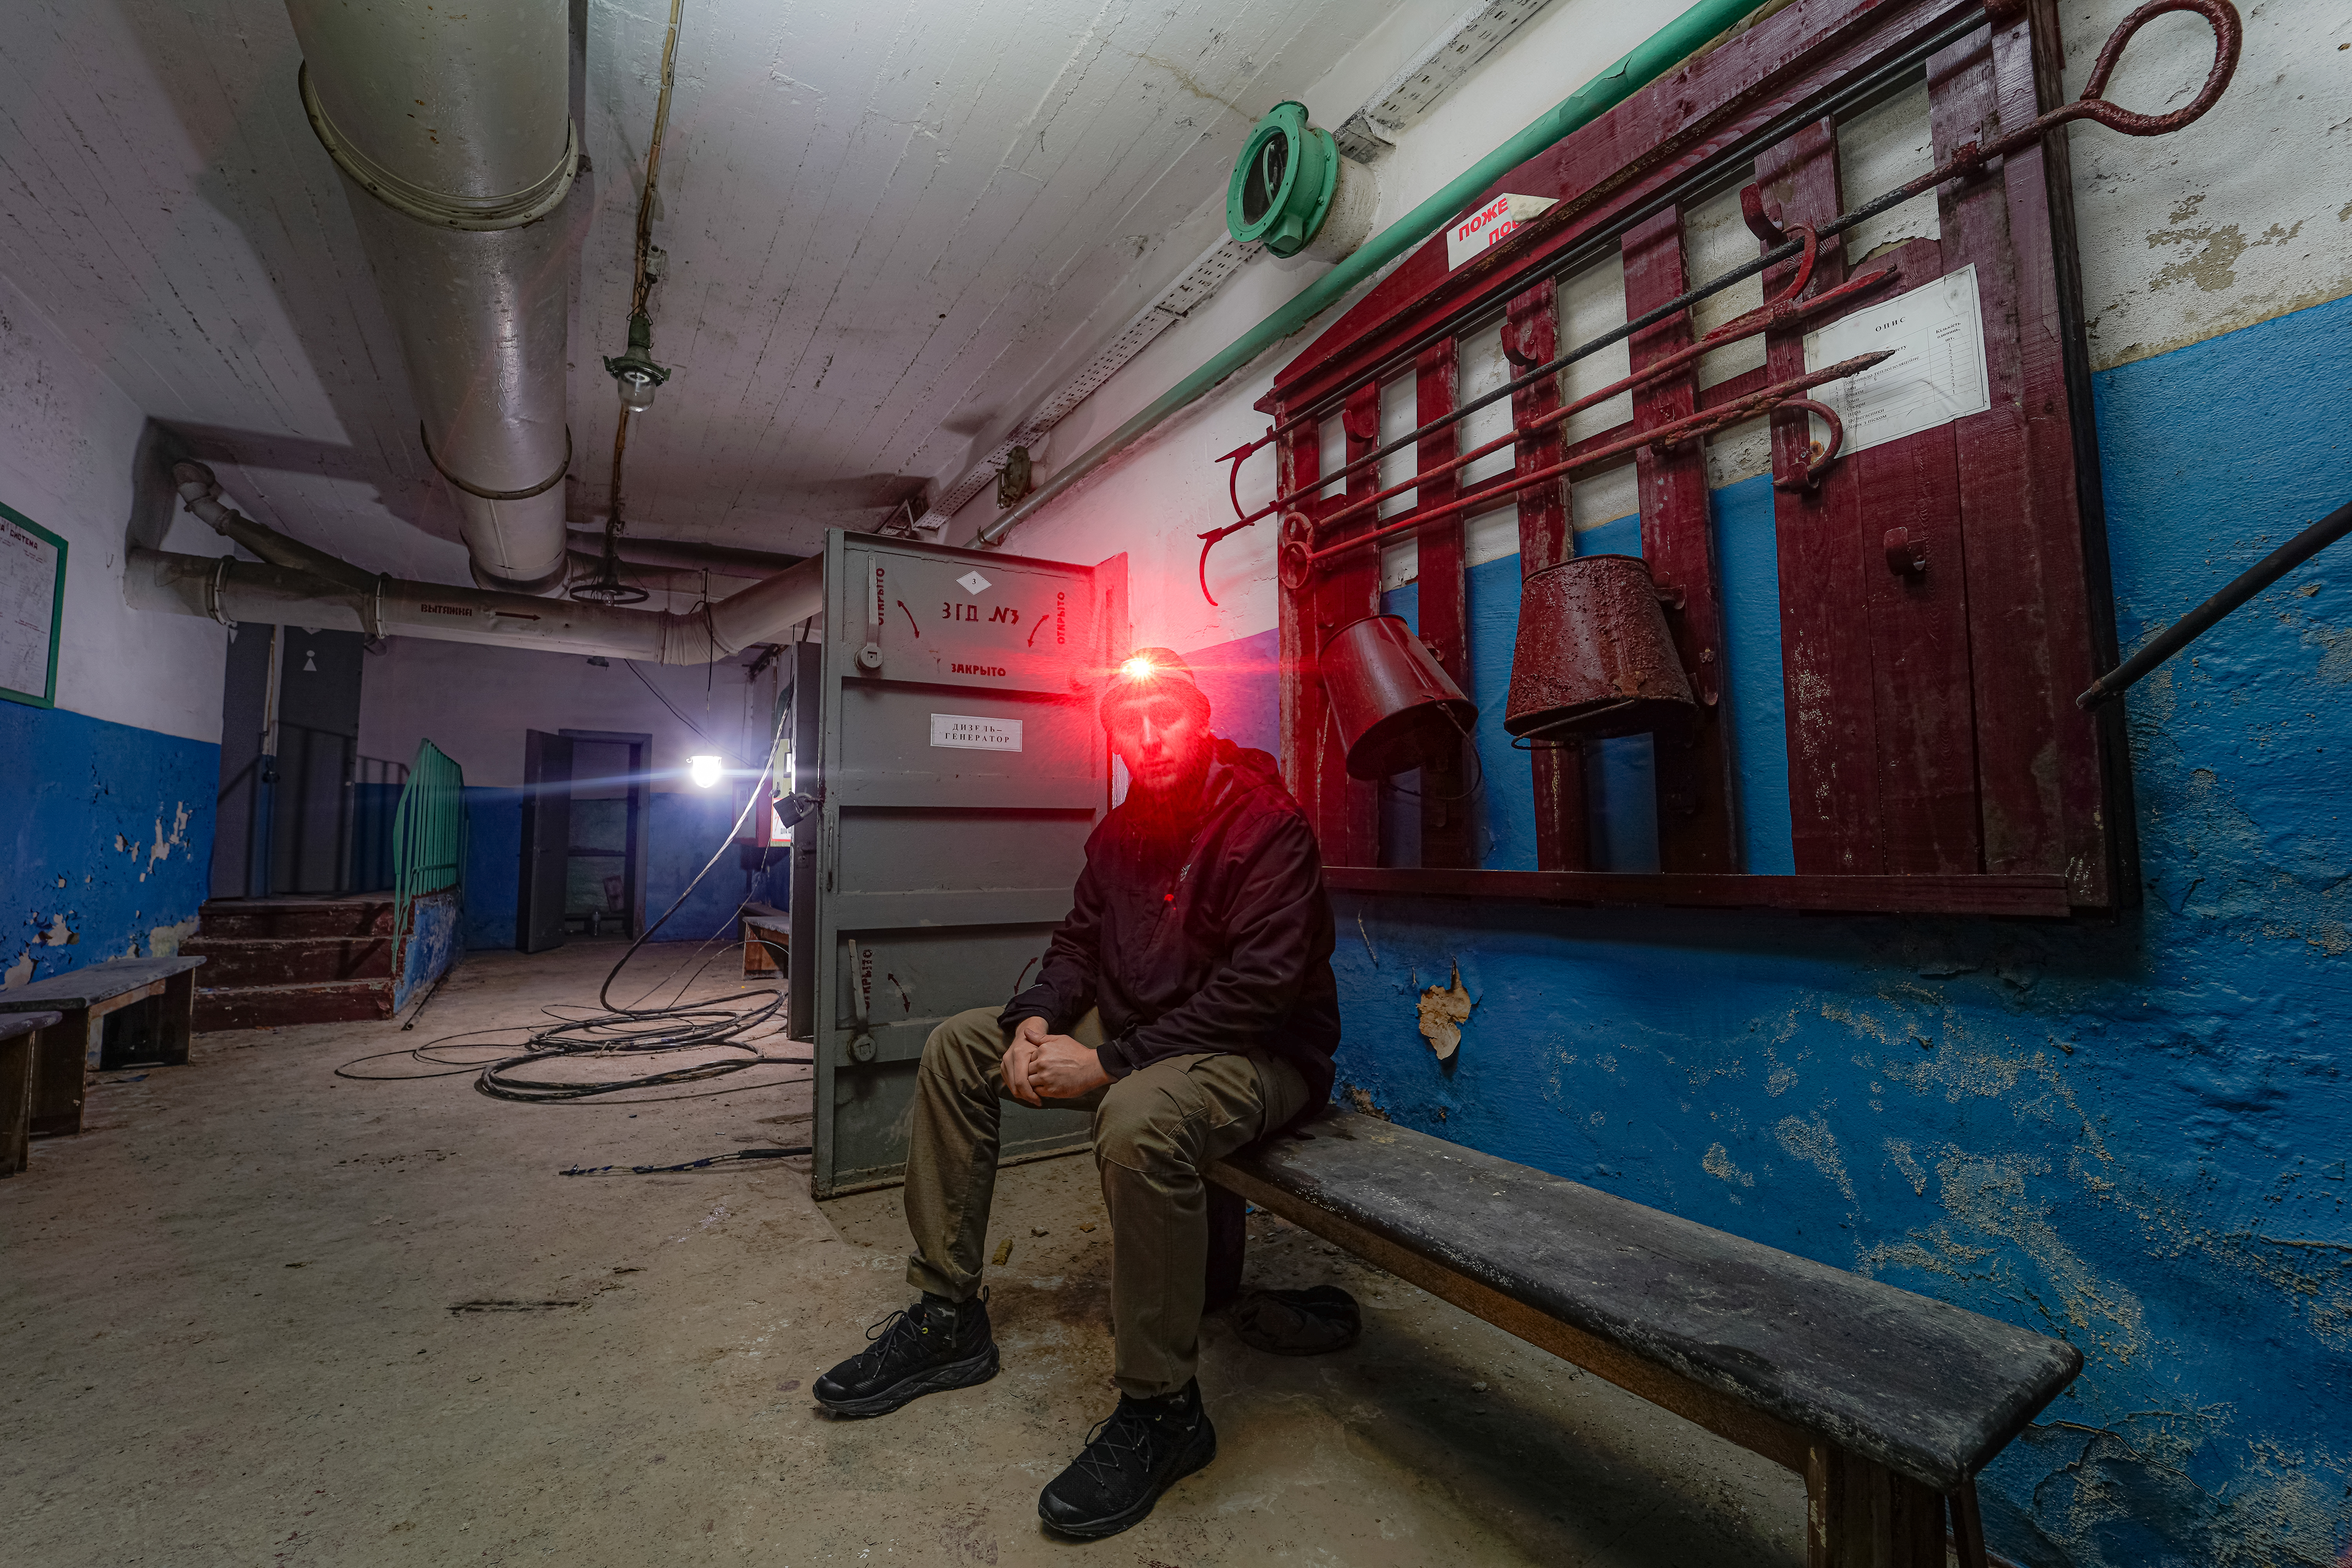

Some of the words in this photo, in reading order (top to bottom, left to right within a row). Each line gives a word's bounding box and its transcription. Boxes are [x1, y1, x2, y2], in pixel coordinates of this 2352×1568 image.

[1875, 317, 1906, 332] ОПИС
[1845, 390, 1864, 399] Лопати
[1868, 414, 1887, 424] піском
[10, 530, 37, 550] СИСТЕМА
[942, 602, 978, 622] ЗГД
[1057, 592, 1065, 644] ОТКРЫТО
[951, 663, 1006, 677] ЗАКРЫТО
[945, 733, 1009, 743] ГЕНЕРАТОР
